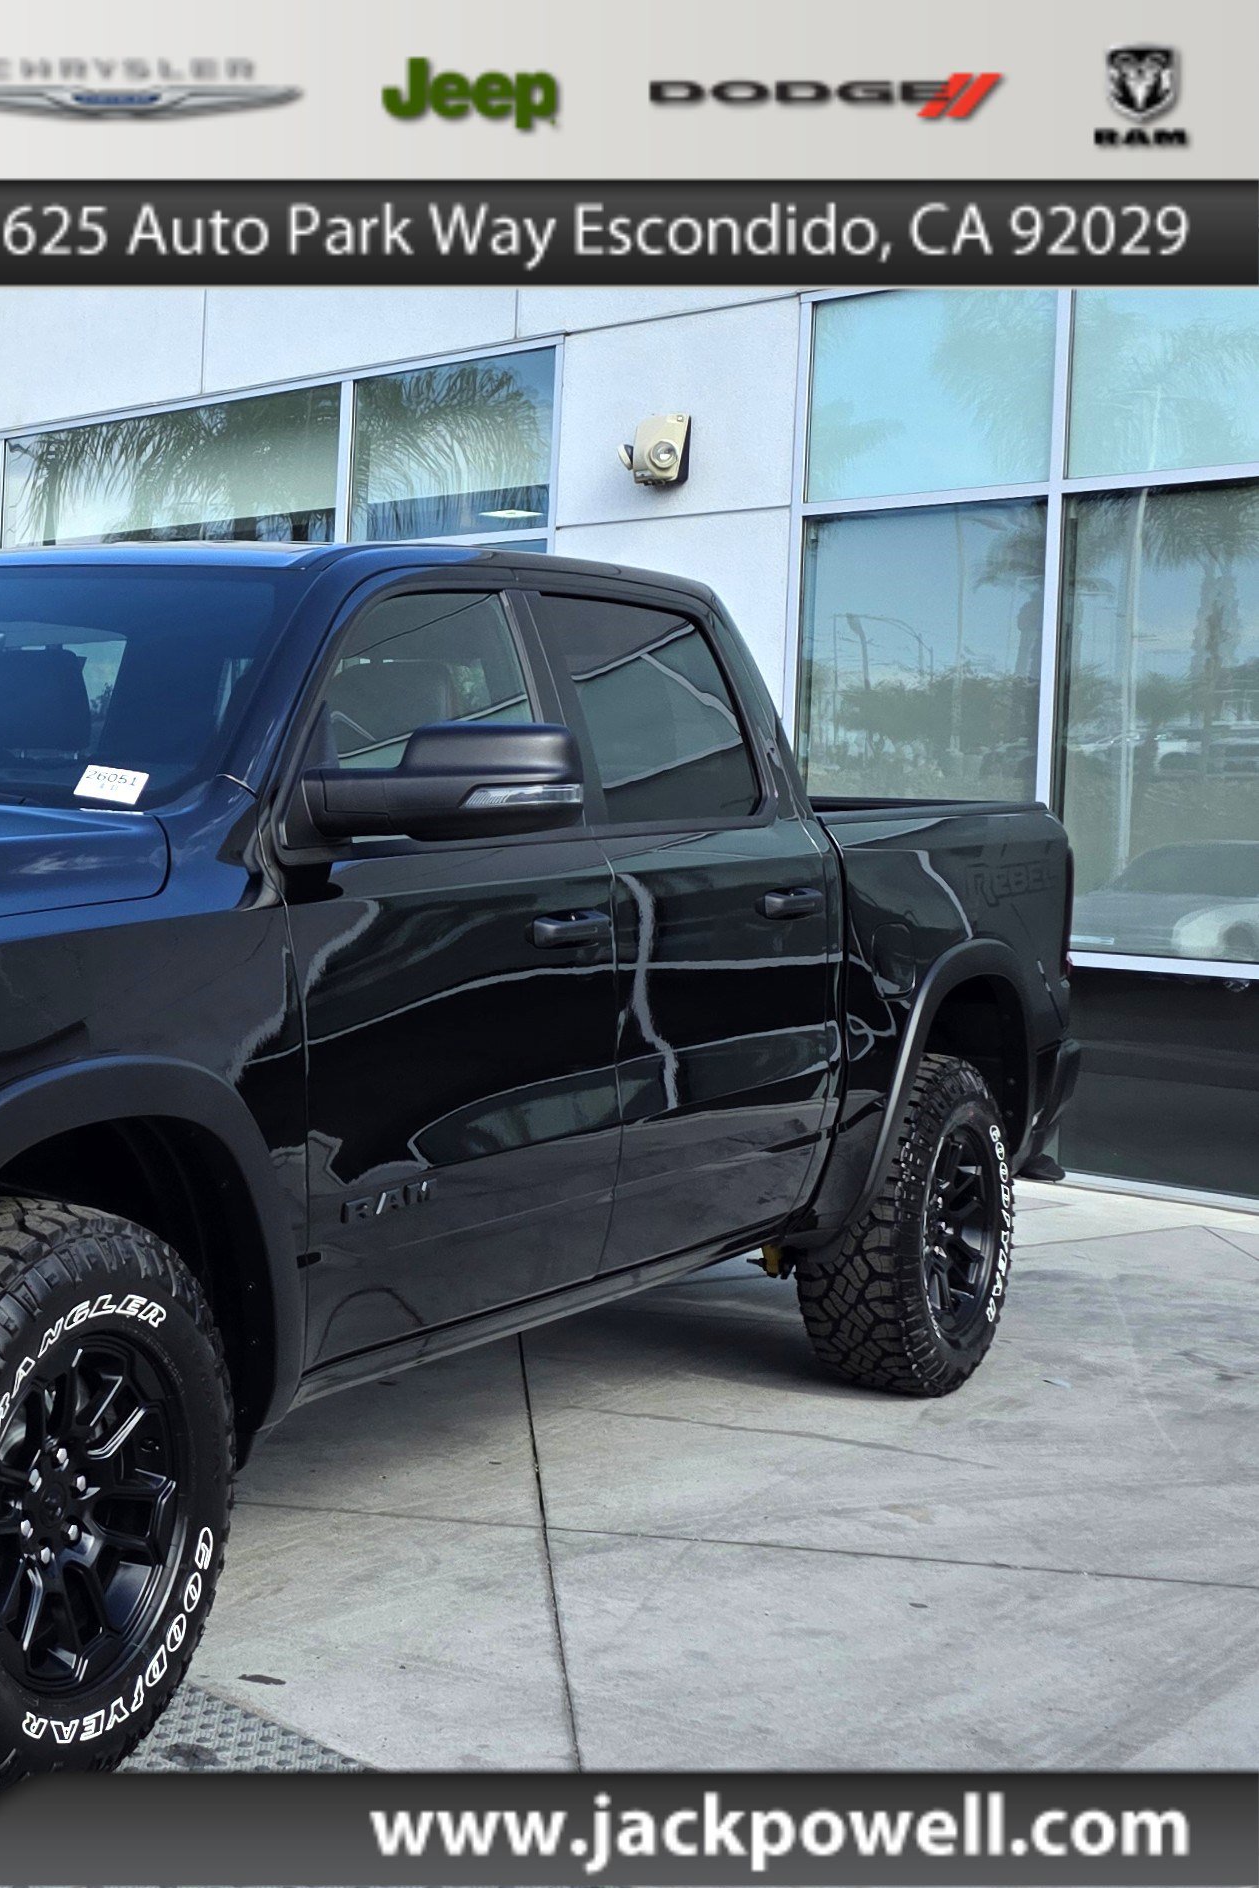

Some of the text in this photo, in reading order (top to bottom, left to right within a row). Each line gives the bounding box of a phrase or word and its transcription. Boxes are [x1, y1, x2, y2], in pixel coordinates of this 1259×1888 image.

[85, 769, 139, 787] 26051
[340, 1179, 438, 1224] RAM
[987, 1125, 1010, 1323] GOODYEAR
[21, 1526, 214, 1745] GOODYEAR
